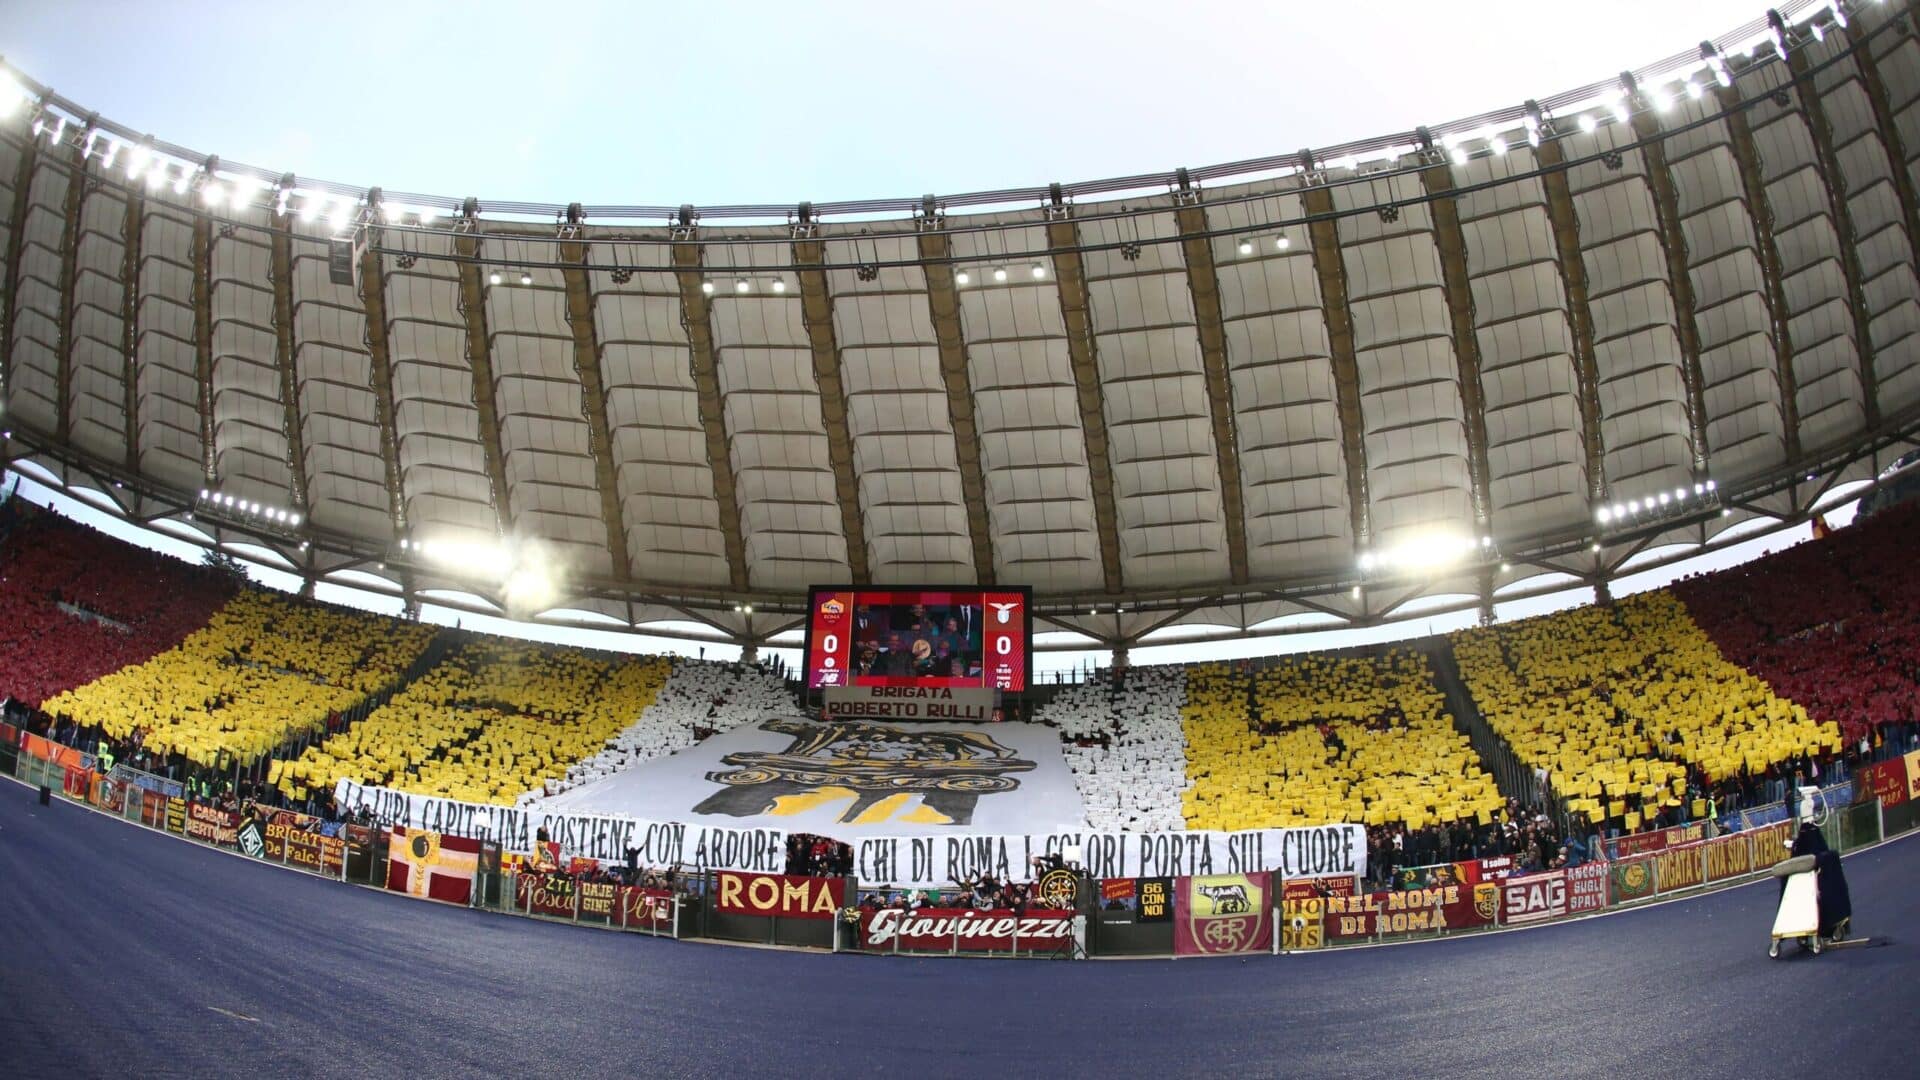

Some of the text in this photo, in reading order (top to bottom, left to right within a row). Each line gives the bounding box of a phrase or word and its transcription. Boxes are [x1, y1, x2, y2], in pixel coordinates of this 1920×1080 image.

[823, 634, 838, 654] 0
[996, 635, 1011, 655] 0
[871, 686, 952, 699] BRIGATA
[828, 702, 984, 719] ROBERTO RULLI
[265, 823, 321, 847] BRIGAT
[374, 789, 411, 827] LUPA
[544, 814, 637, 862] SOSTIENE
[646, 822, 686, 865] CON
[695, 828, 781, 872] ARDORE
[266, 841, 281, 855] De
[286, 846, 321, 865] Falc
[860, 838, 897, 882] CHI
[912, 837, 934, 882] DI
[947, 836, 1009, 881] ROMA
[1024, 835, 1031, 879] I
[1140, 833, 1212, 878] PORTA
[1228, 831, 1267, 875] SUL
[1282, 826, 1355, 876] CUORE
[1657, 848, 1694, 890] RIGATA
[1694, 839, 1727, 882] CRVA
[1727, 837, 1747, 874] SUD
[1752, 824, 1793, 868] ATERALE
[1567, 862, 1608, 881] ANCORA
[546, 876, 571, 893] ZTL
[720, 873, 837, 914] ROMA
[1143, 882, 1163, 894] 66
[1142, 893, 1165, 905] CON
[1327, 893, 1379, 914] NEL
[1388, 885, 1460, 911] NOME
[1505, 878, 1566, 914] SAG
[1570, 893, 1604, 910] SPALT
[1144, 904, 1164, 916] NOI
[867, 909, 1071, 945] Giovinezza
[1340, 909, 1448, 936] DI ROMA
